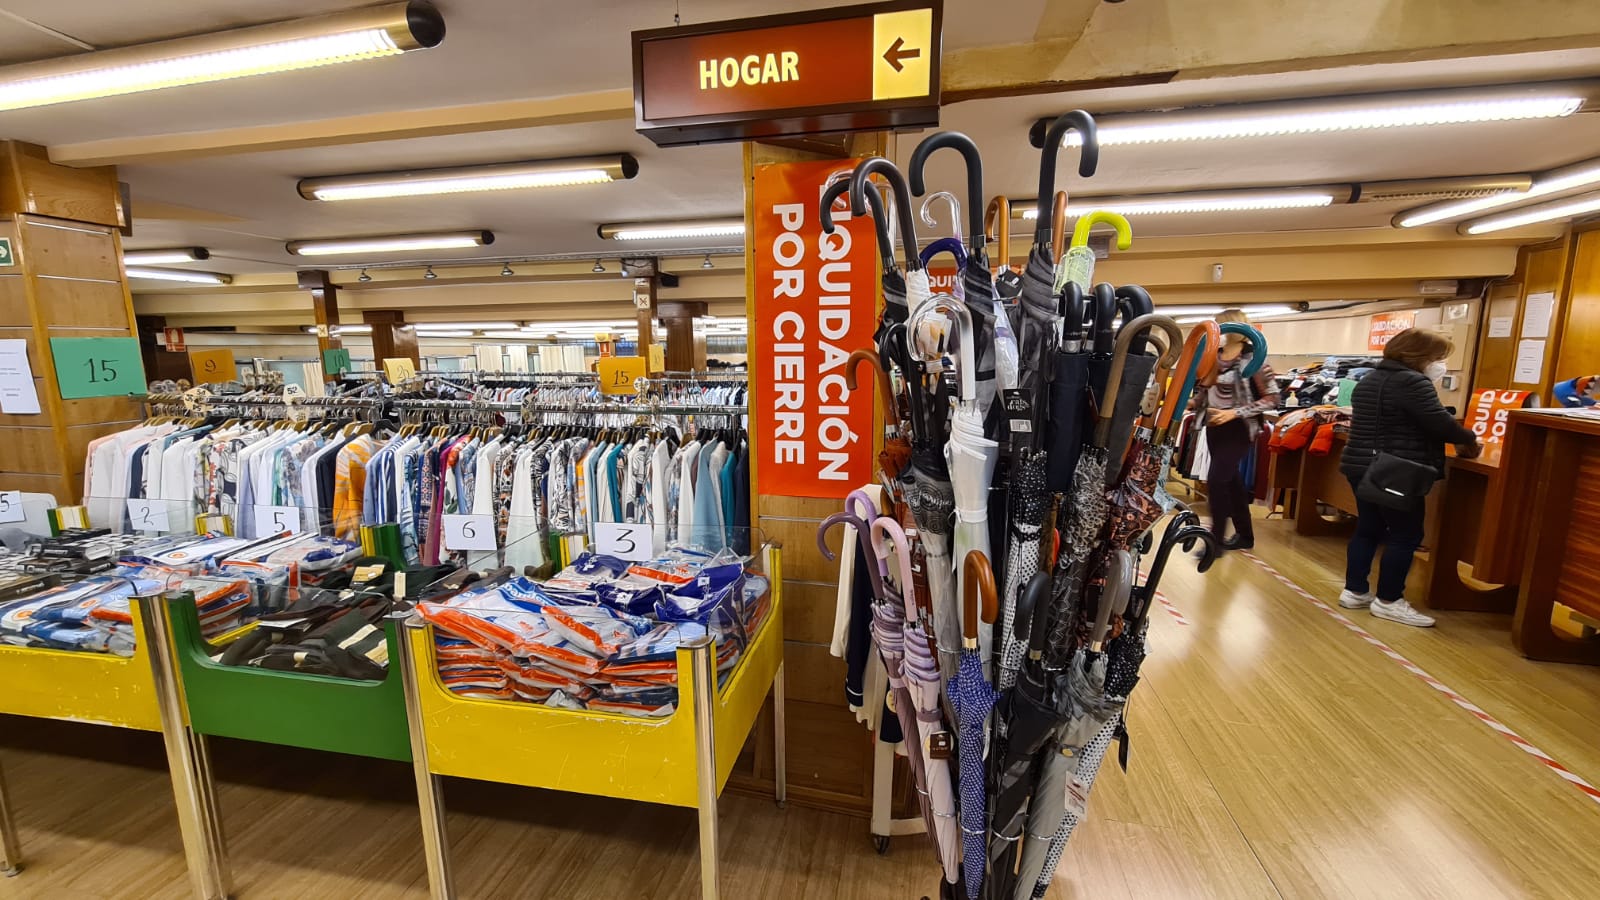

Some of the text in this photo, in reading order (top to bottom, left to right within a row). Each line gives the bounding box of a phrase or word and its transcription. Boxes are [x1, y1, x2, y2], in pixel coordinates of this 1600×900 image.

[699, 51, 799, 90] HOGAR
[772, 203, 805, 465] POR CIERRE
[818, 184, 859, 481] IQUIDACIÓN
[83, 358, 120, 383] 15
[204, 359, 217, 373] 9
[613, 369, 630, 386] 15
[0, 493, 10, 513] 5
[140, 506, 154, 526] 2
[273, 511, 286, 533] 5
[462, 520, 476, 539] 6
[613, 528, 636, 553] 3
